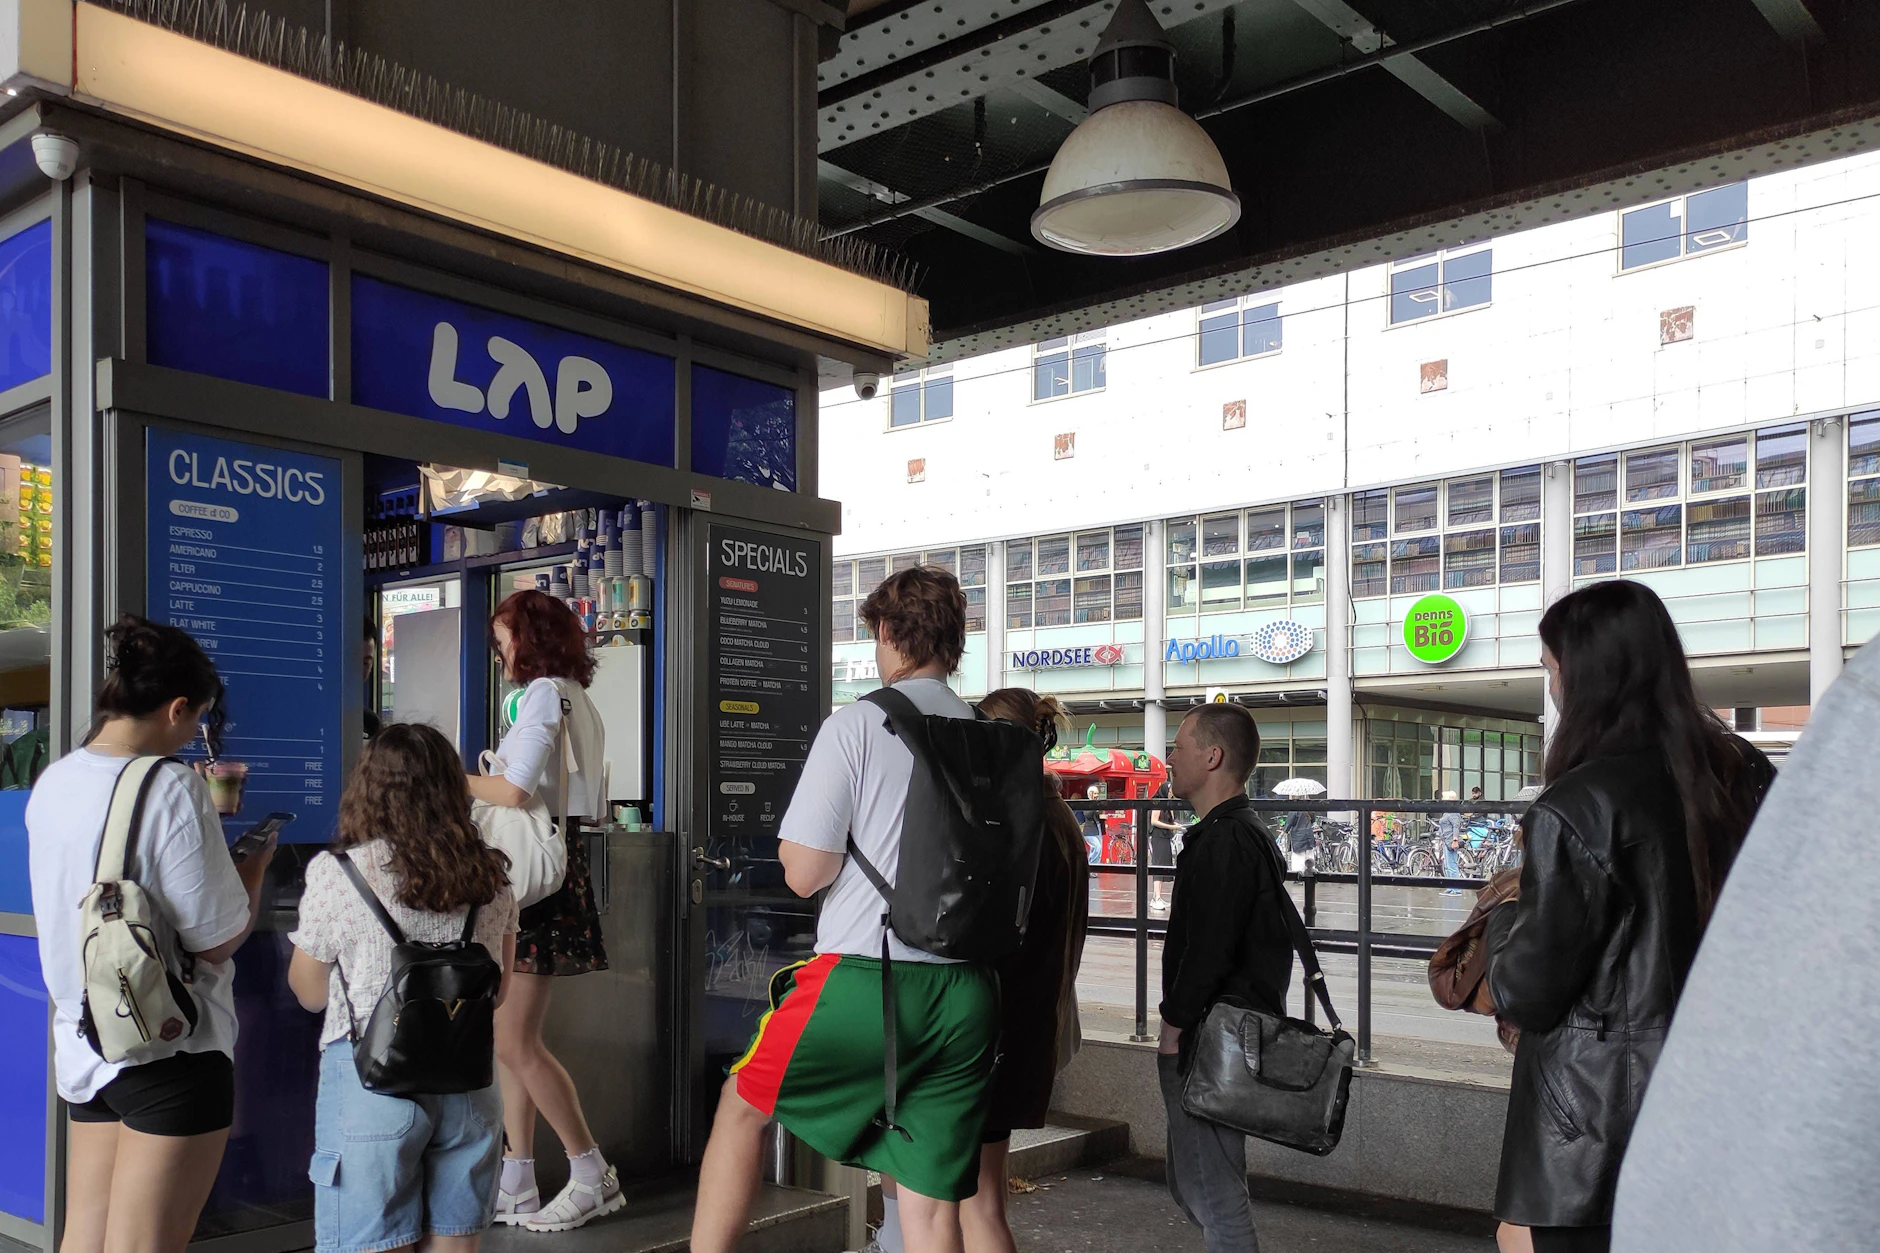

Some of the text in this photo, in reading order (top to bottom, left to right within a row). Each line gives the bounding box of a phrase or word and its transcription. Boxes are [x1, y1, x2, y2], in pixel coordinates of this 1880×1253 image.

[428, 321, 613, 435] LAP
[168, 449, 325, 506] CLASSICS
[178, 504, 208, 517] COFFEE
[219, 509, 231, 519] CO
[169, 526, 213, 540] ESPRESSO
[169, 544, 217, 558] AMERICANO
[721, 539, 808, 577] SPECIALS
[169, 562, 195, 574] FILTER
[317, 562, 323, 572] 2
[169, 580, 222, 595] CAPPUCCINO
[725, 579, 755, 591] SIGNATURES
[391, 592, 408, 601] FÜR
[411, 593, 433, 601] ALLE!
[169, 599, 195, 611] LATTE
[733, 598, 759, 608] LEMONADE
[316, 613, 323, 623] 3
[720, 616, 767, 629] BLUEBERRY MATCHA
[169, 618, 216, 631] FLAT WHITE
[316, 631, 323, 640] 3
[1414, 621, 1454, 648] Bio
[720, 636, 770, 649] COCO MATCHA CLOUD
[316, 648, 323, 658] 3
[1165, 634, 1240, 667] Apollo
[720, 657, 744, 667] COLLAGEN
[745, 659, 764, 668] MATCHA
[1012, 647, 1092, 669] NORDSEE
[720, 677, 739, 686] PROTEIN
[740, 679, 757, 688] COFFEE
[763, 680, 782, 689] MATCHA
[726, 702, 754, 712] SEASONALS
[719, 720, 730, 728] UBE
[730, 720, 745, 729] LATTE
[750, 721, 770, 730] MATCHA
[720, 740, 773, 750] MANGO MATCHA CLOUD
[305, 762, 323, 771] FREE
[720, 760, 786, 770] STRAWBERRY CLOUD MATCHA
[305, 779, 323, 788] FREE
[305, 796, 323, 805] FREE
[722, 814, 776, 822] IN-HOUSE RECUP
